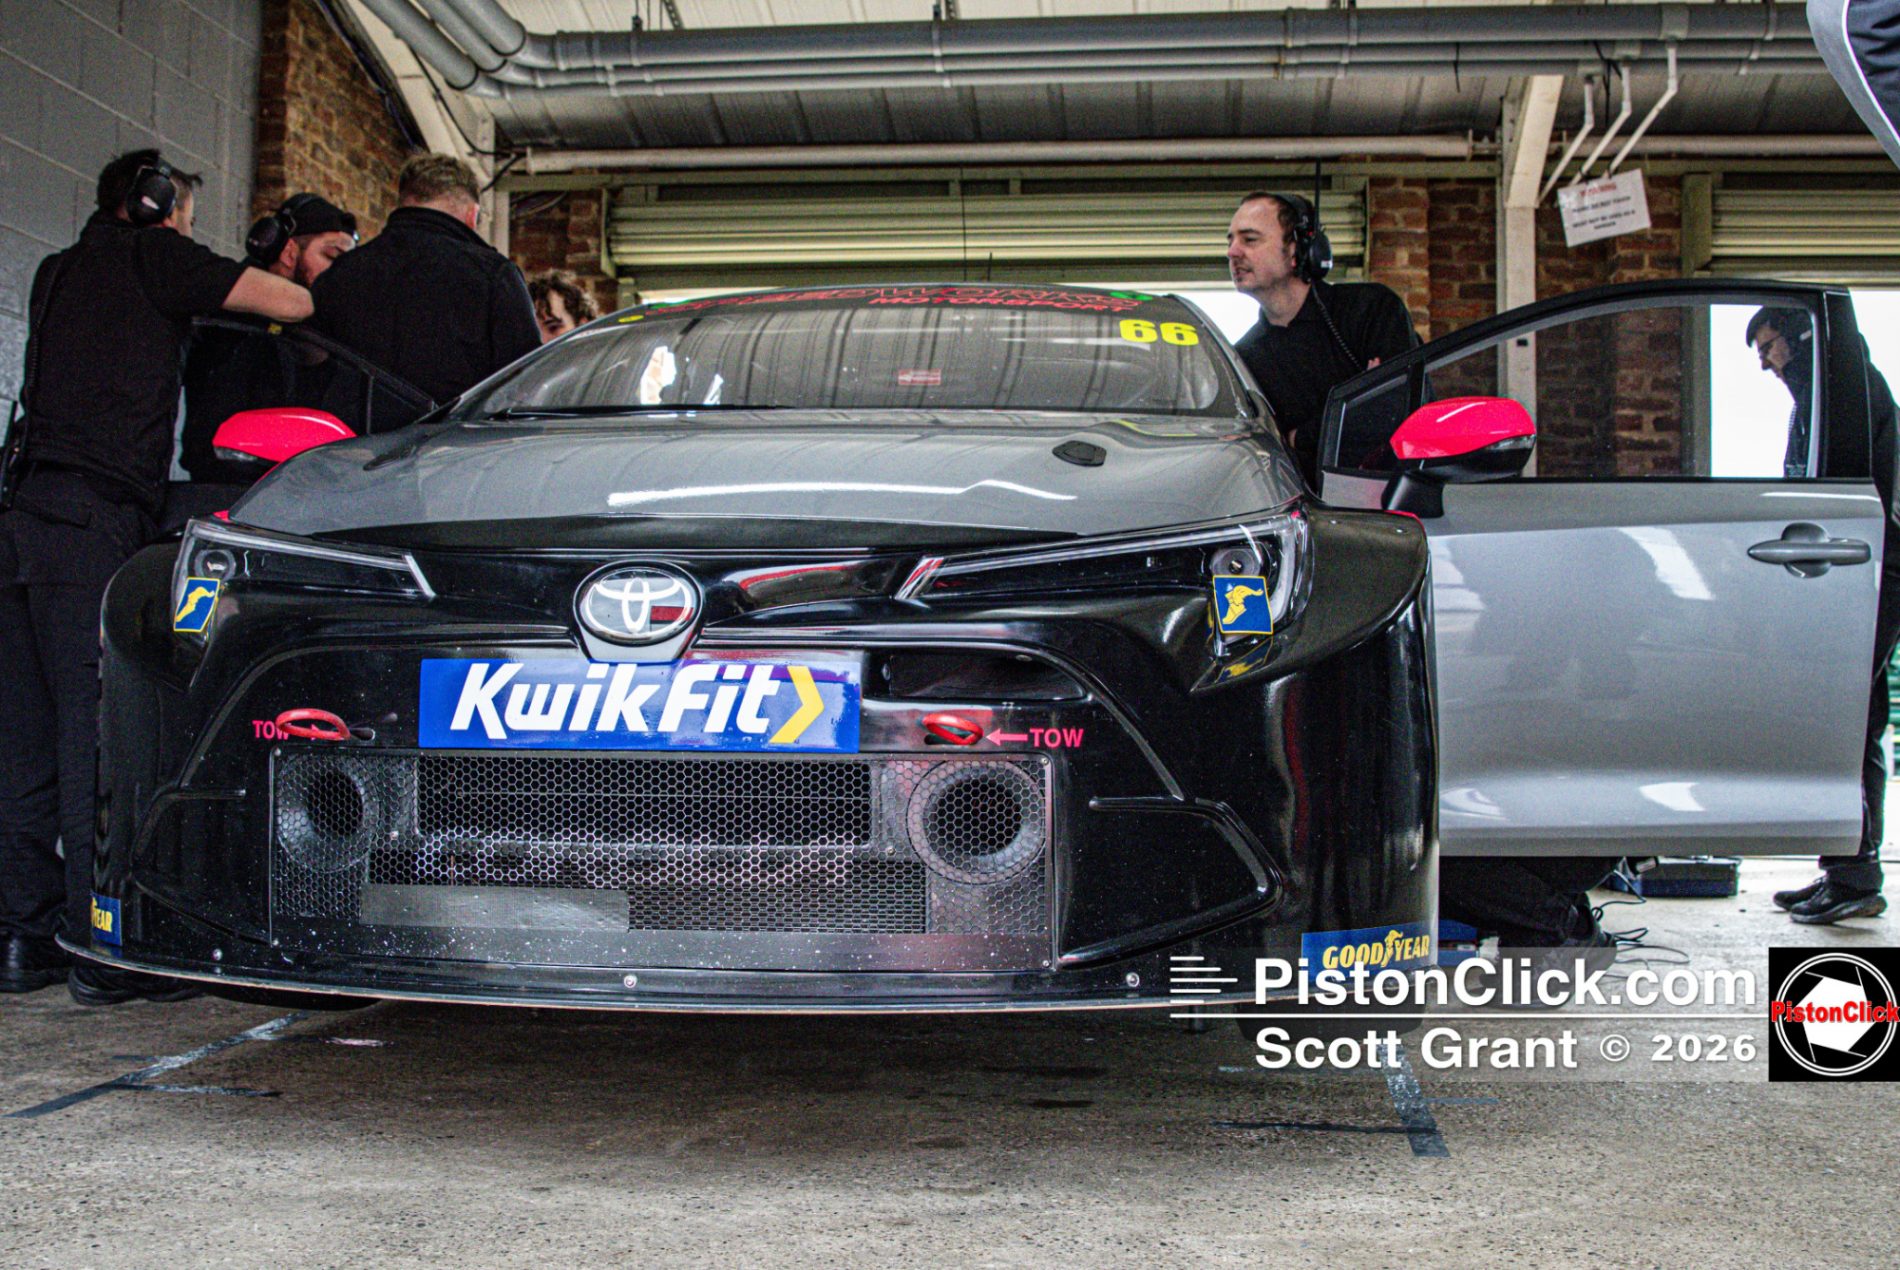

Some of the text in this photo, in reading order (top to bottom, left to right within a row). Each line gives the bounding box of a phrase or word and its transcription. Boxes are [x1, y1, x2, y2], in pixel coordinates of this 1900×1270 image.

[869, 297, 1135, 313] MOTORSPORT
[1118, 319, 1199, 346] 66
[1029, 727, 1084, 748] TOW
